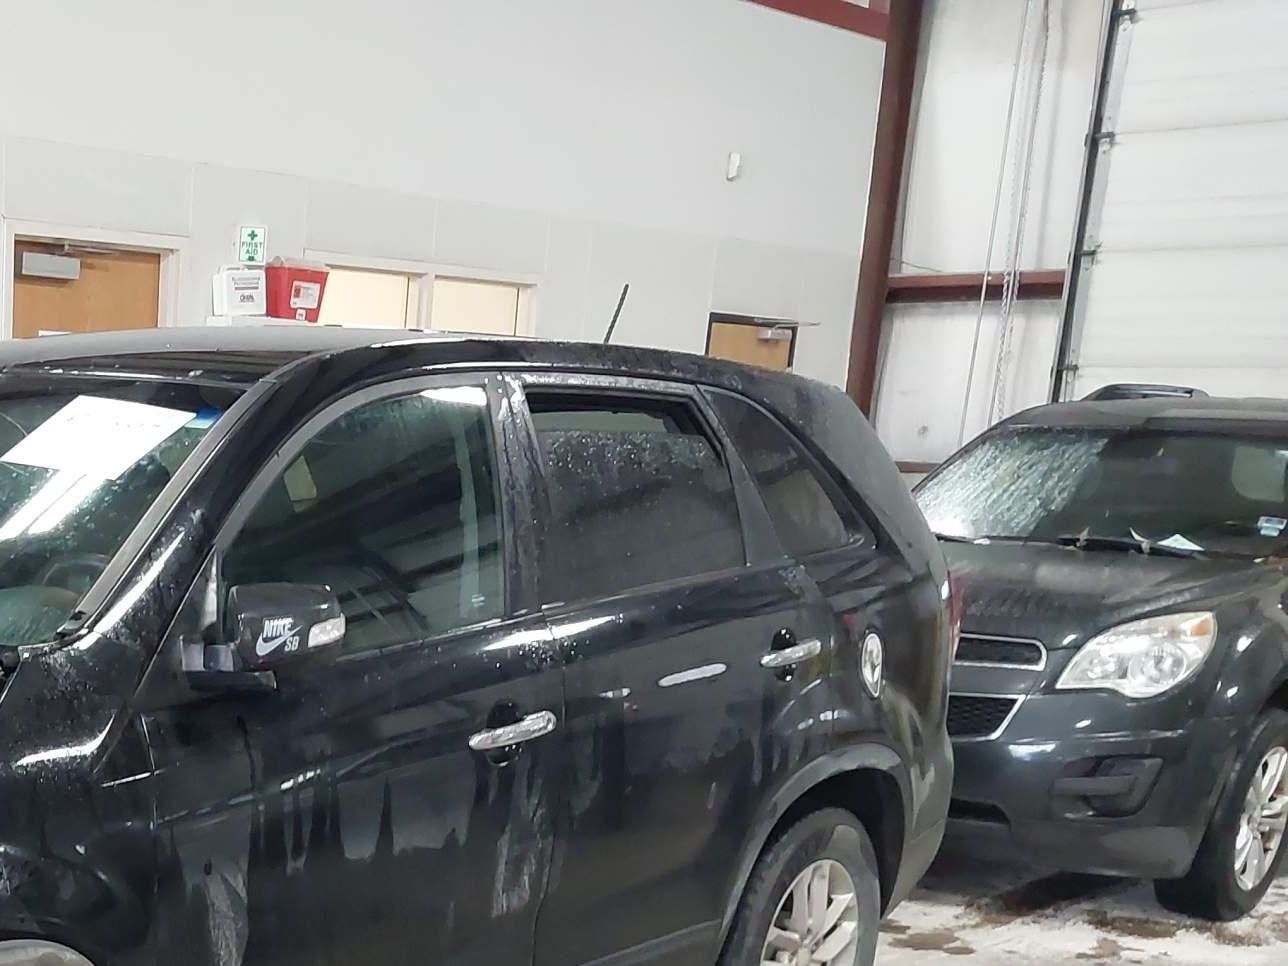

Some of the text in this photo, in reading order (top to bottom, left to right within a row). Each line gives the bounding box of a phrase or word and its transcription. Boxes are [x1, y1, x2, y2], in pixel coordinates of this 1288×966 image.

[241, 241, 263, 249] FIRST
[245, 248, 259, 256] AID
[262, 617, 295, 638] NIKE
